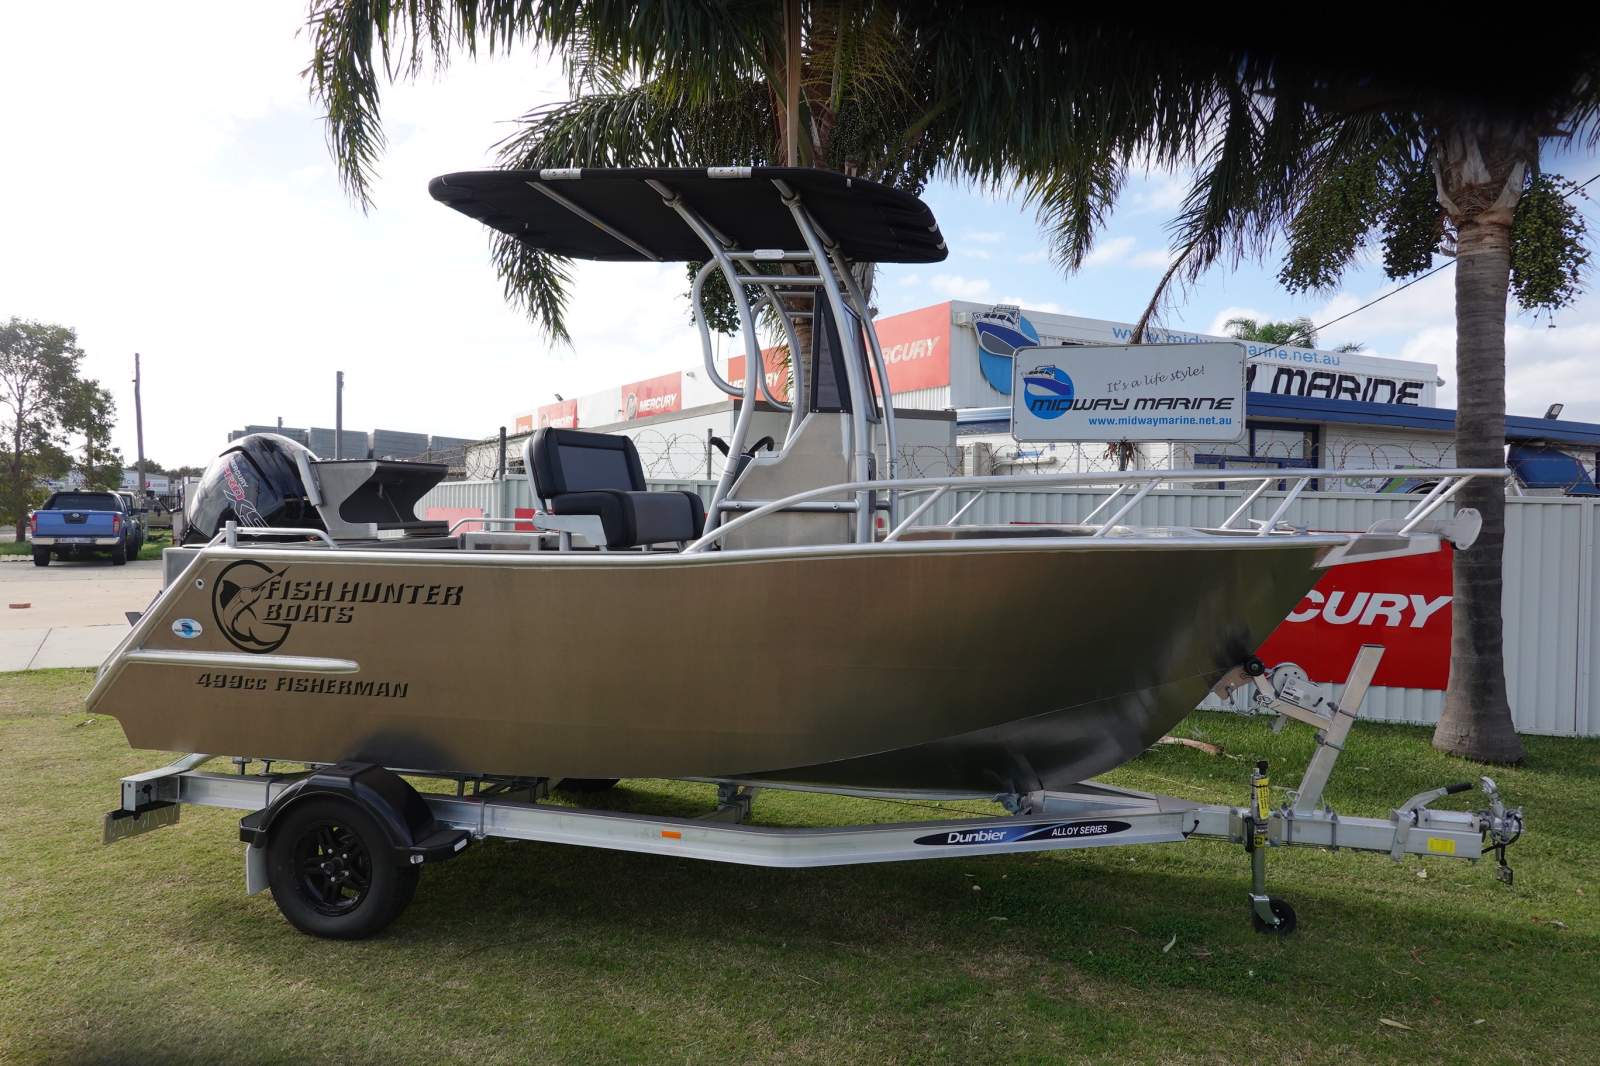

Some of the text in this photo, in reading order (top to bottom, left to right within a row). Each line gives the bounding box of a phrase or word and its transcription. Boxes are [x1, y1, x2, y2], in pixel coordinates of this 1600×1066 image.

[1107, 380, 1128, 392] It's
[1144, 372, 1168, 385] life
[1170, 364, 1205, 381] style!
[1271, 367, 1424, 406] MARINE
[639, 393, 678, 412] MERCURY
[1031, 397, 1234, 411] MIDWAY MARINE
[1088, 416, 1232, 427] www.midwaymarine.net.au
[265, 581, 464, 606] FISH HUNTER
[263, 604, 354, 624] BOATS
[1285, 589, 1453, 628] CURY
[274, 677, 409, 698] FISHERMAN
[947, 825, 1107, 844] Dunbier ALLOY SERIES
